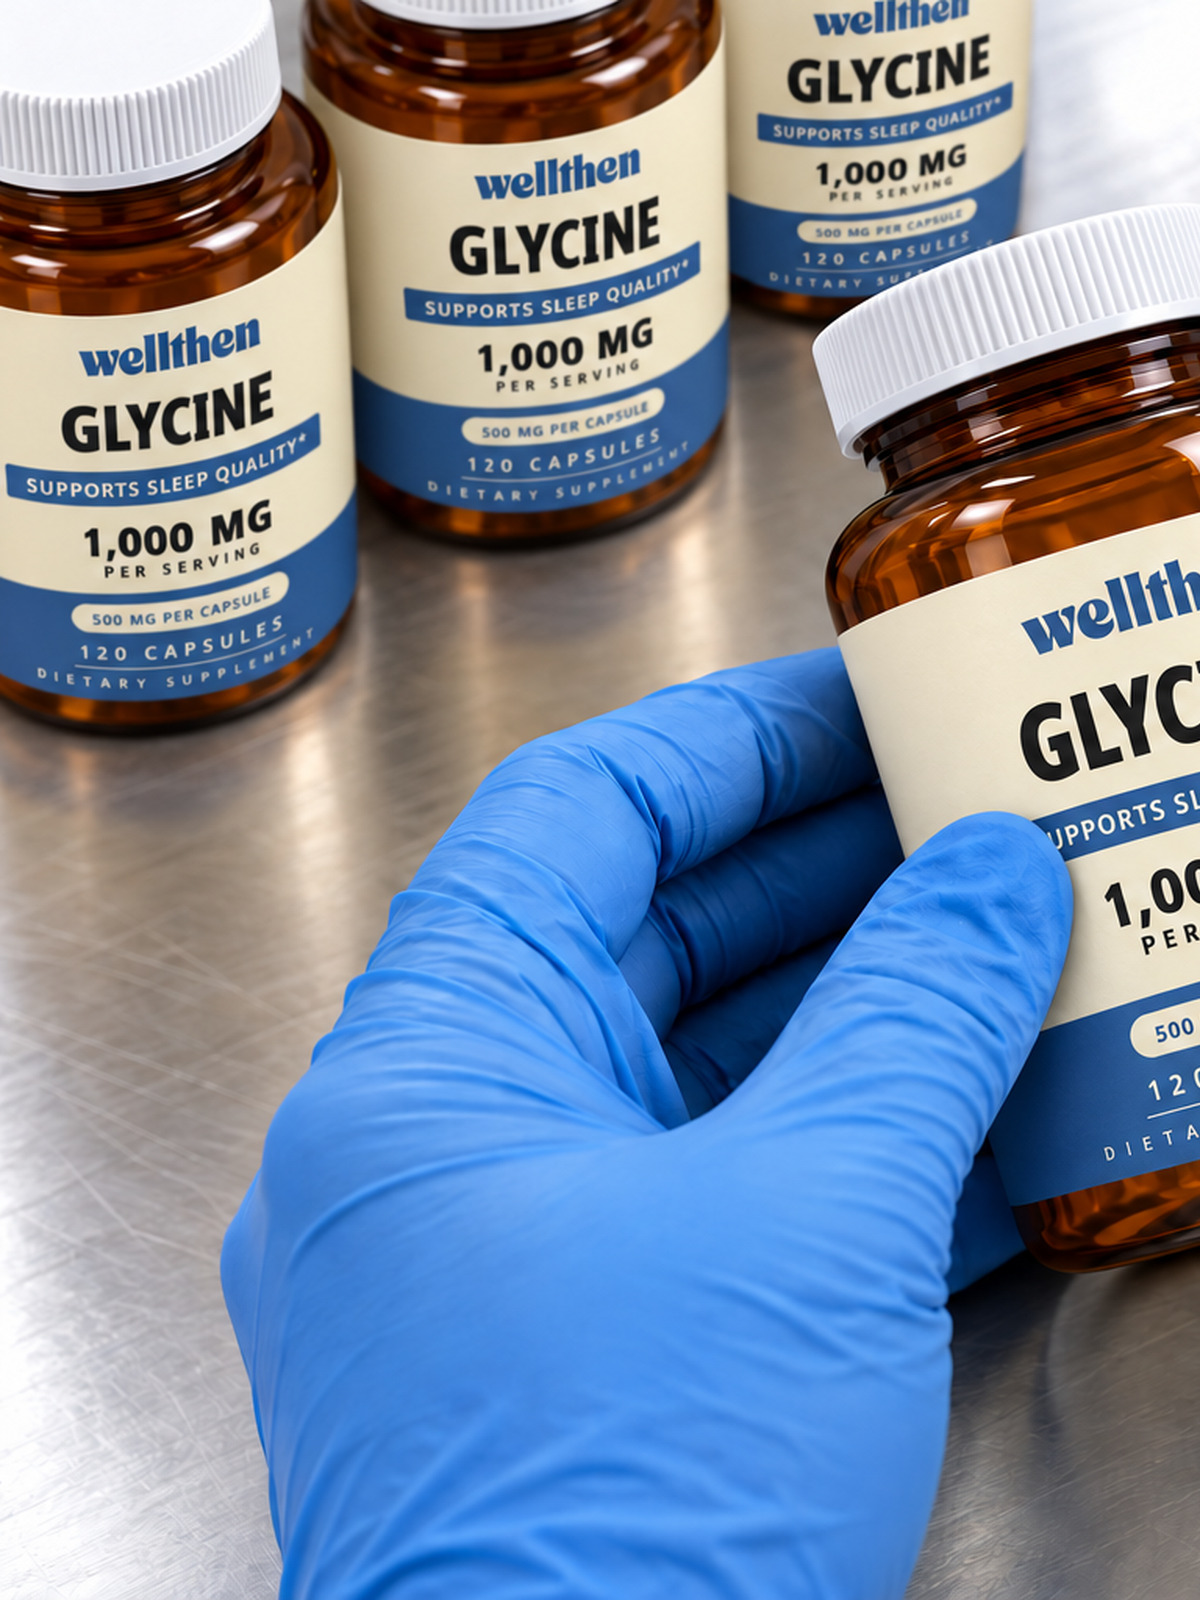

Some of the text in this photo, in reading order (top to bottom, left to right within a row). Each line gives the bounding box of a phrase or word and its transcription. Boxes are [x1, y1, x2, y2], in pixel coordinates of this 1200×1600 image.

[787, 34, 990, 103] GLYCINE
[773, 124, 863, 141] SUPPORTS
[869, 121, 920, 139] SLEEP
[474, 148, 641, 200] wellthen
[816, 144, 967, 188] 1,000 MG
[830, 176, 954, 202] PER SERVING
[449, 195, 660, 275] GLYCINE
[815, 209, 963, 238] 500 MG PER CAPSULE
[802, 252, 844, 265] 120
[859, 230, 970, 264] CAPSULES
[769, 272, 861, 288] DIETARY
[425, 301, 533, 318] SUPPORTS
[541, 292, 599, 315] SLEEP
[78, 318, 260, 376] wellthen
[478, 317, 653, 376] 1,000 MG
[496, 359, 640, 392] PER SERVING
[61, 370, 274, 453] GLYCINE
[482, 401, 649, 438] 500 MG PER CAPSULE
[428, 441, 688, 500] DIETARY SUPPLEMENT
[467, 428, 660, 472] 120 CAPSULES
[26, 477, 139, 498] SUPPORTS
[147, 472, 208, 495] SLEEP
[84, 499, 272, 561] 1,000 MG
[104, 542, 260, 578] PER SERVING
[92, 586, 271, 626] 500 MG PER CAPSULE
[37, 627, 314, 689] DIETARY SUPPLEMENT
[80, 615, 283, 661] 120 CAPSULES
[1047, 800, 1165, 850] UPPORTS
[1141, 922, 1199, 956] PER
[1155, 1016, 1195, 1043] 500
